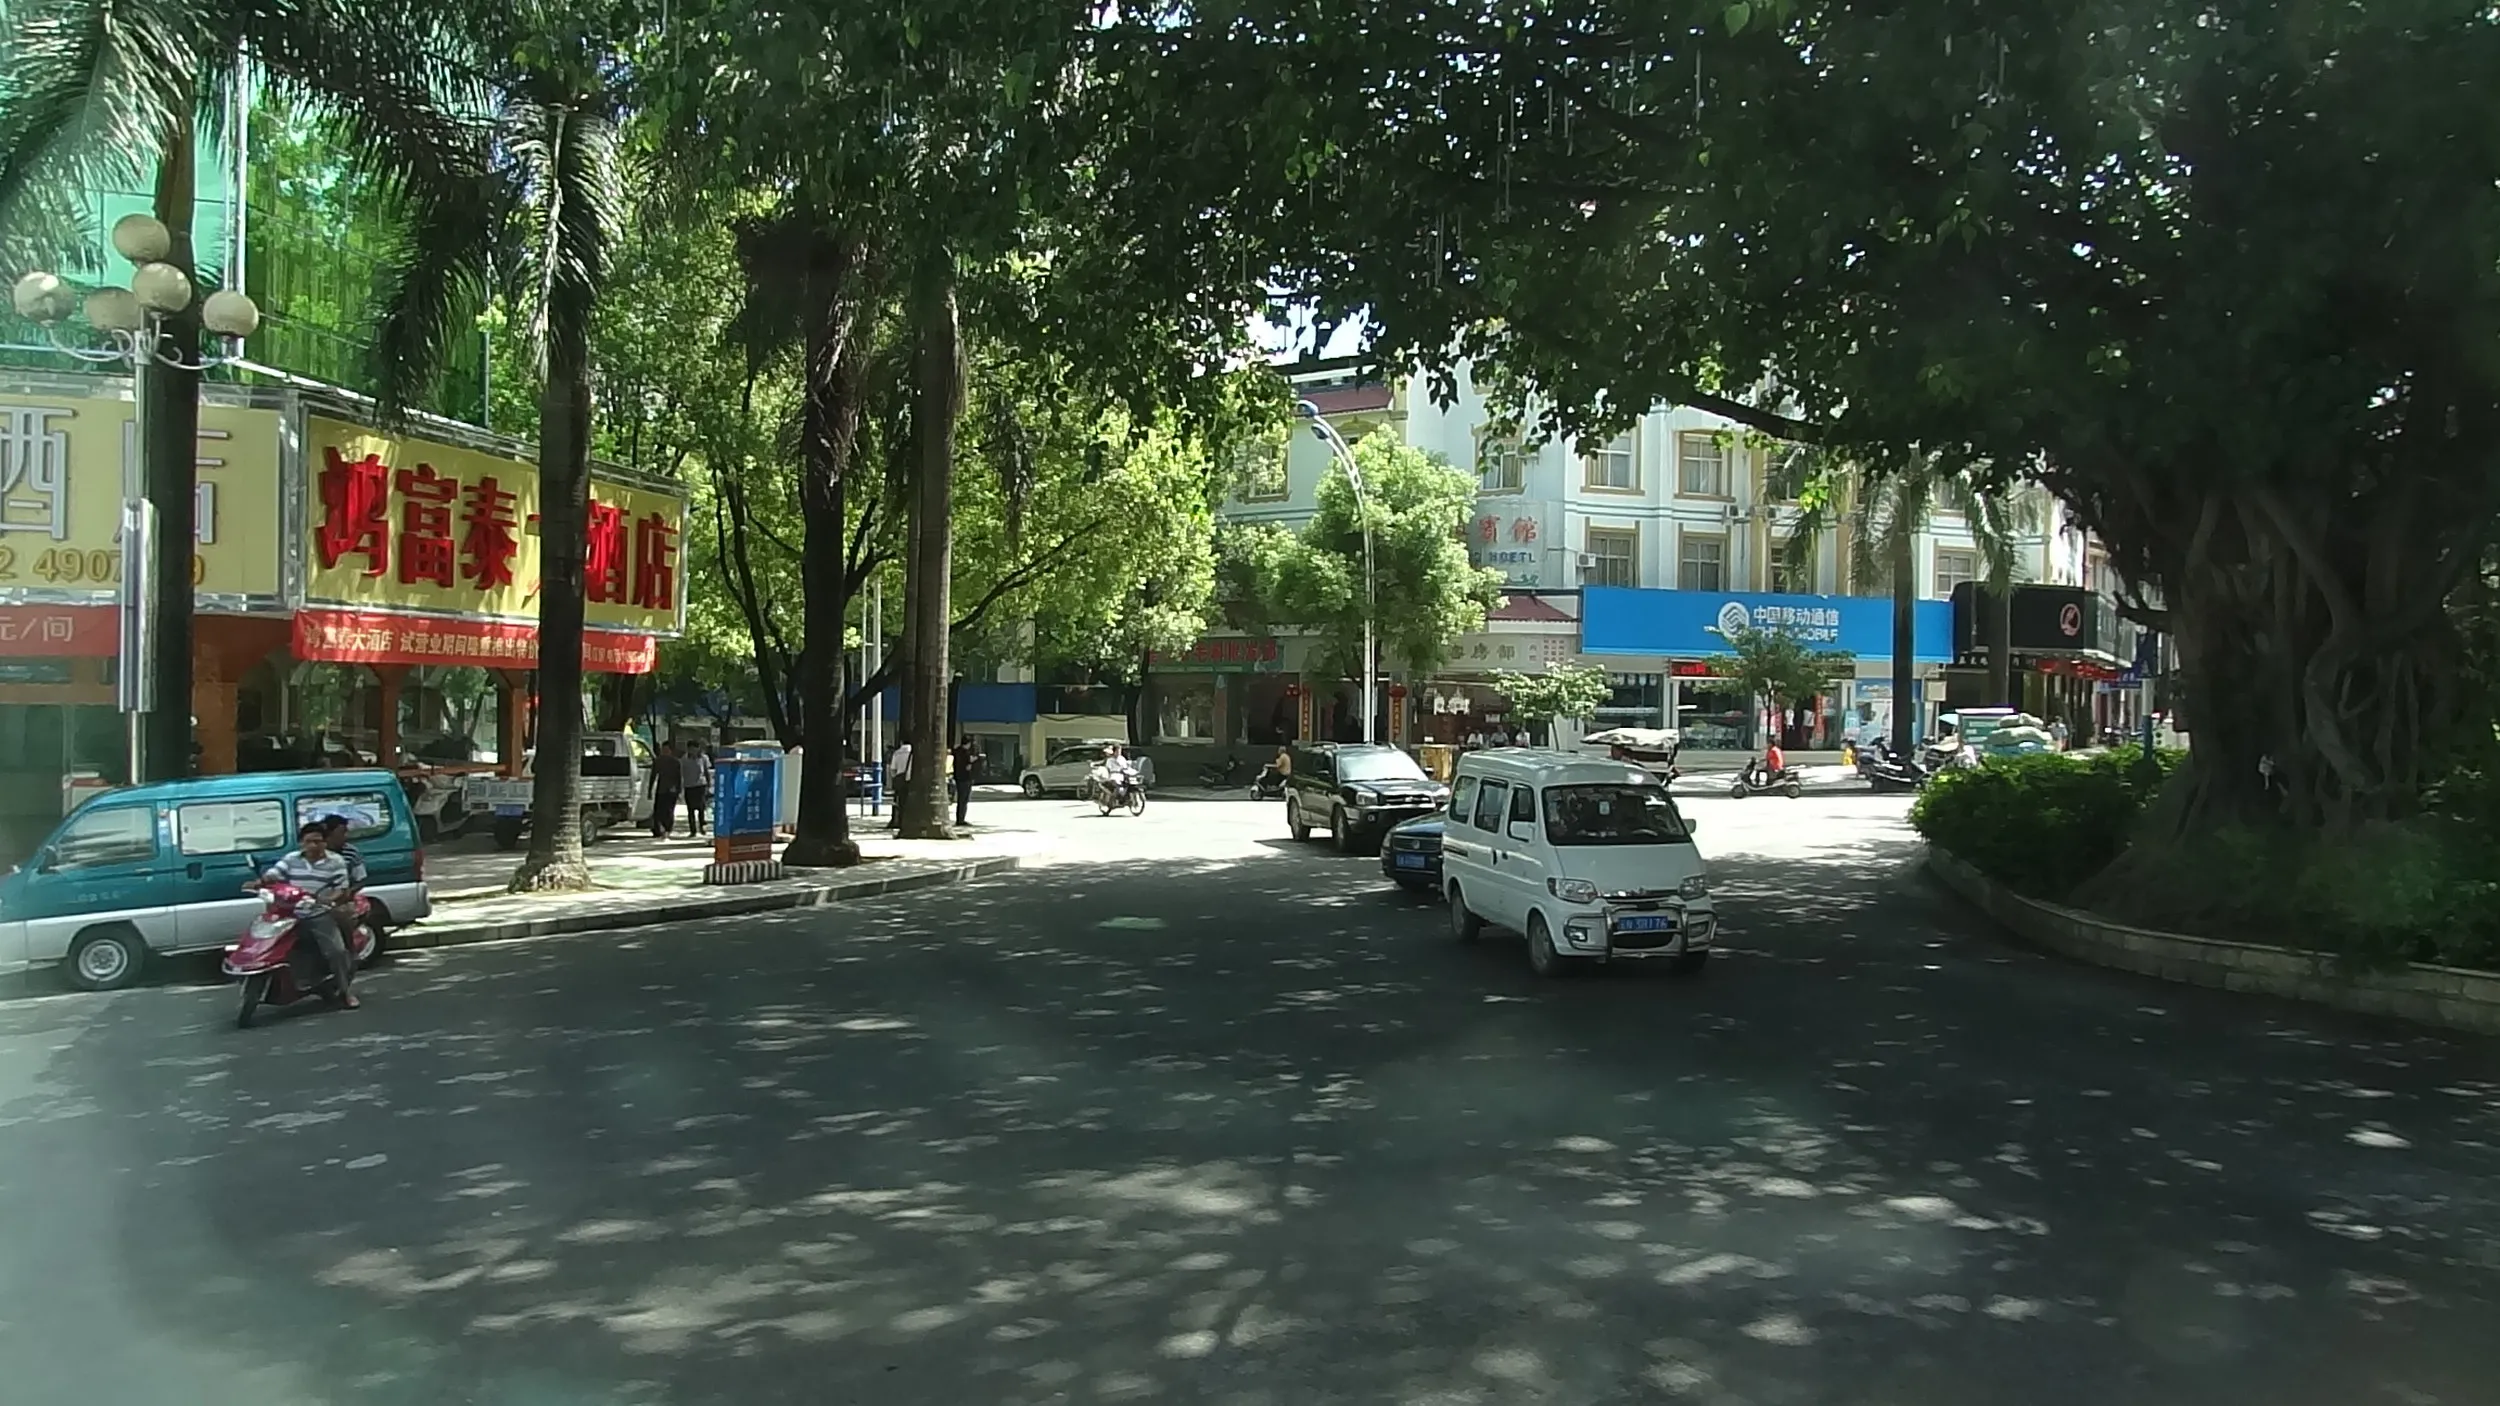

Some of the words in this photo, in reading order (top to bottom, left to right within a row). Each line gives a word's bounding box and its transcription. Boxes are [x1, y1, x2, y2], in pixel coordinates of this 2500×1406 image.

[315, 447, 677, 609] 鸿富泰酒店
[1753, 604, 1840, 627] 中国移动通信
